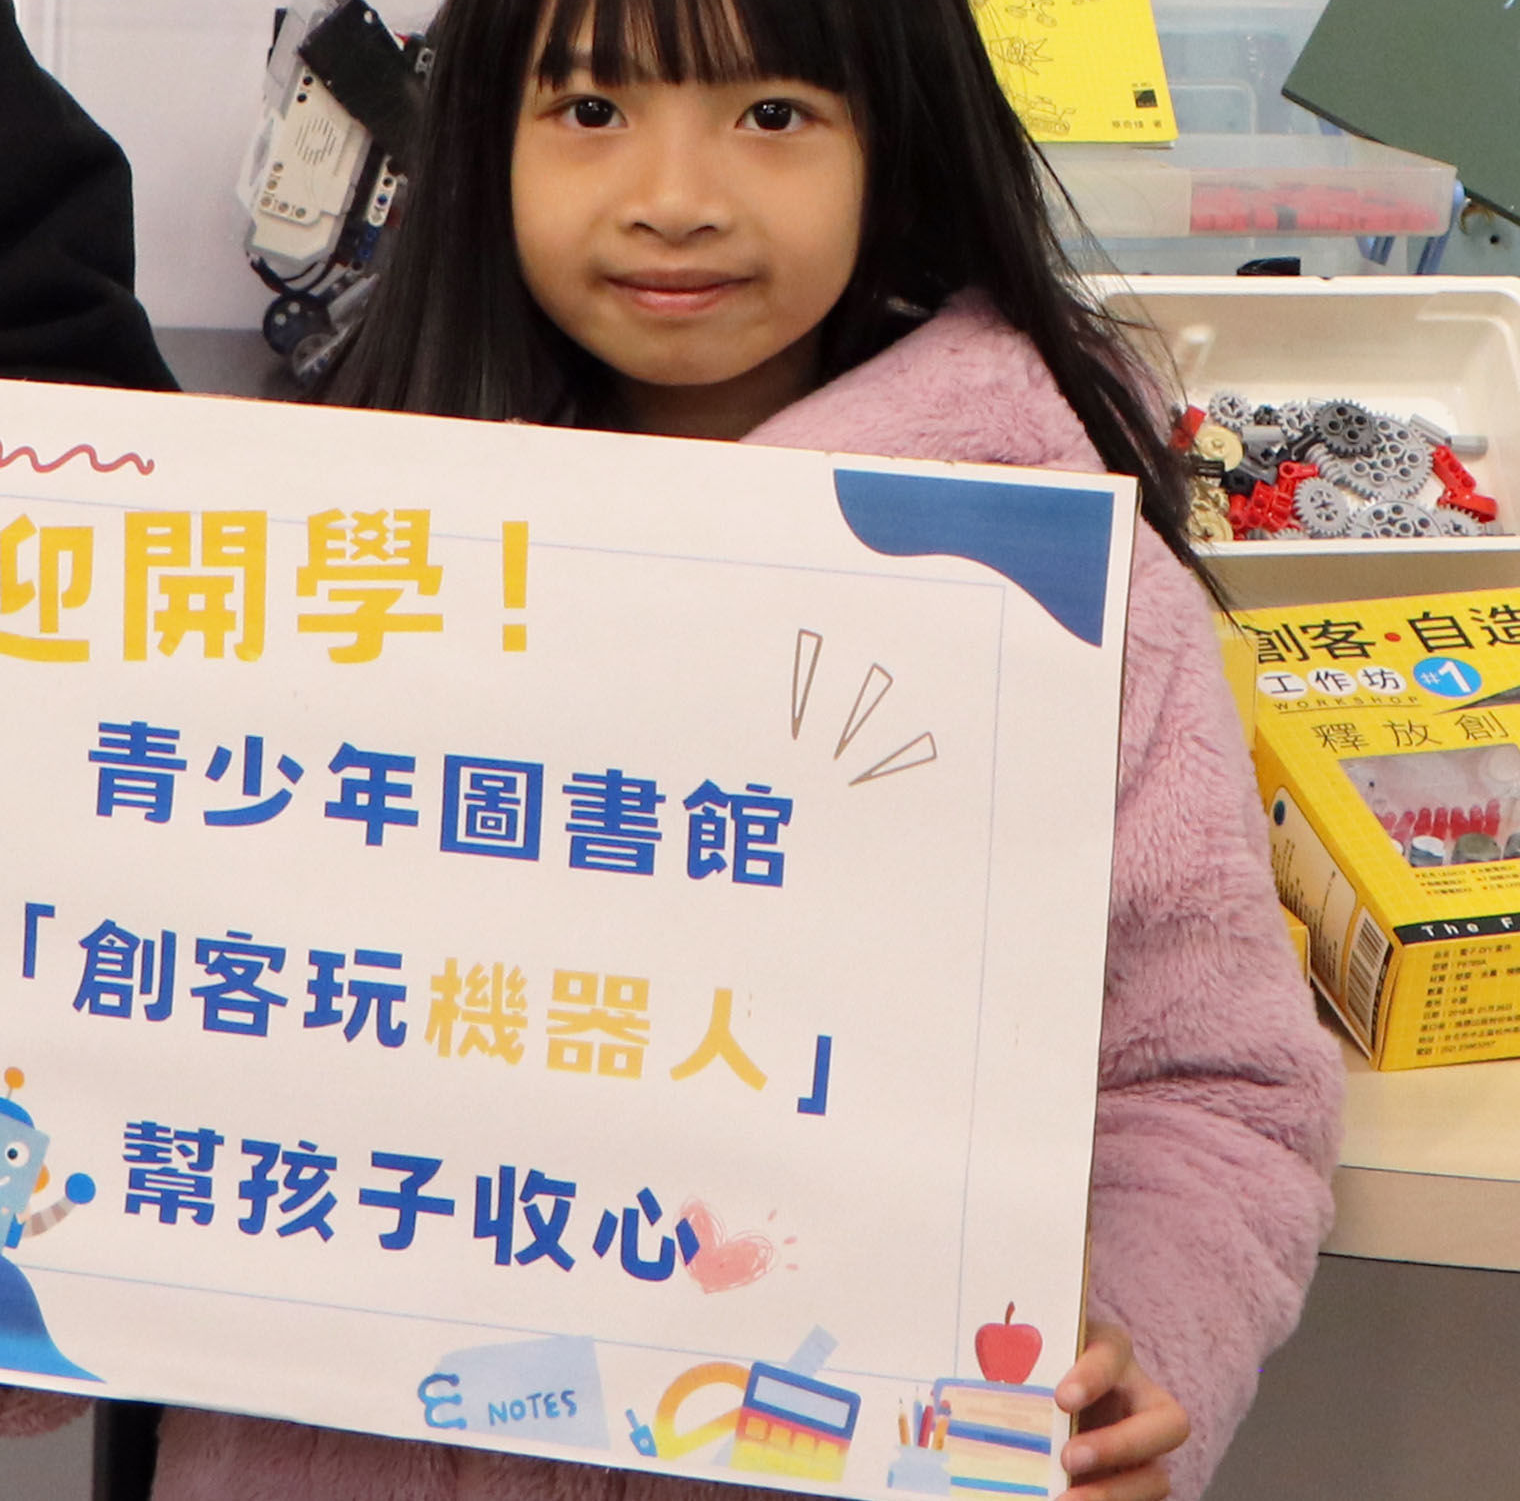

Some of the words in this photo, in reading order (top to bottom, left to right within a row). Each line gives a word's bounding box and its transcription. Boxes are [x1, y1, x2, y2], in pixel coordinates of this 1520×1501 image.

[1263, 667, 1403, 695] 工作坊
[1419, 659, 1473, 694] #1
[1273, 695, 1421, 711] WORKSHOP
[87, 719, 797, 891] 青少年圖書館
[1420, 918, 1480, 938] The
[17, 899, 835, 1120] 「創客玩機器人」
[119, 1118, 701, 1285] 幫孩子收心
[486, 1389, 579, 1428] NOTES
